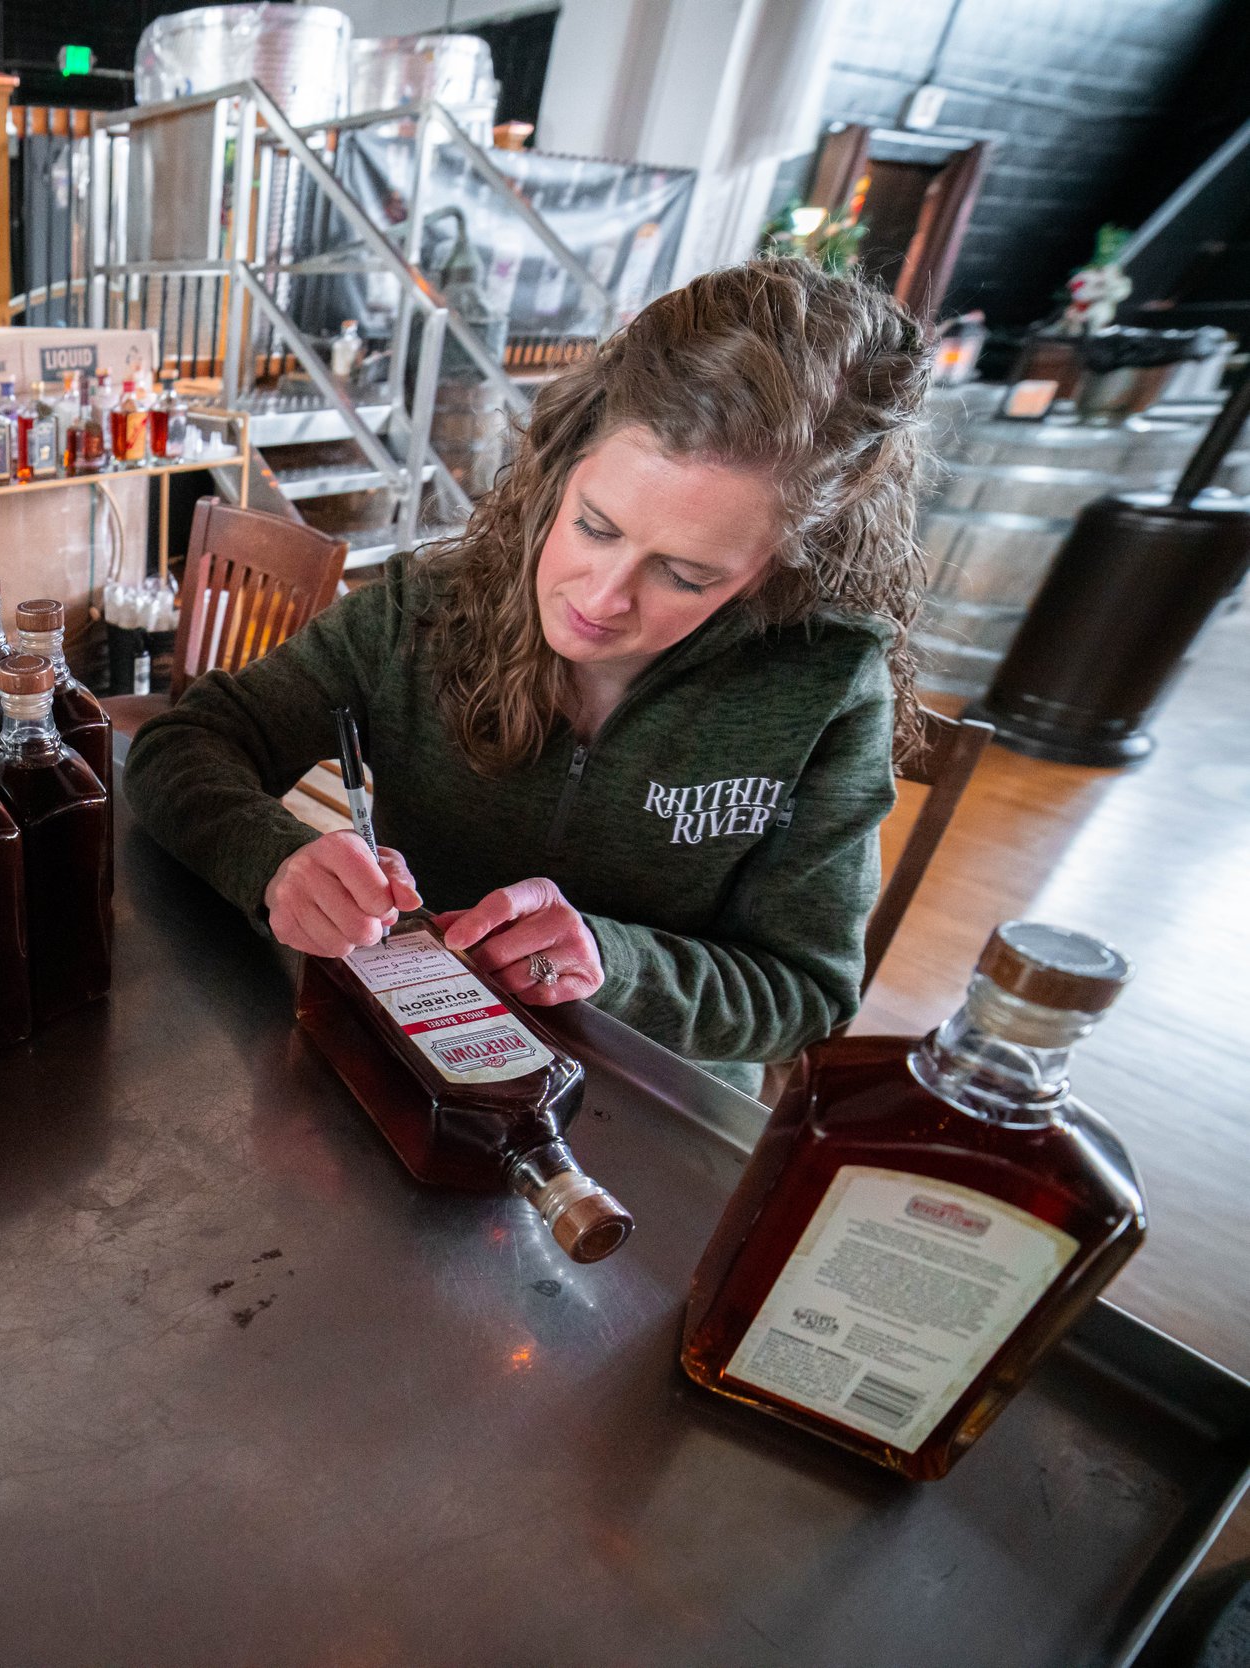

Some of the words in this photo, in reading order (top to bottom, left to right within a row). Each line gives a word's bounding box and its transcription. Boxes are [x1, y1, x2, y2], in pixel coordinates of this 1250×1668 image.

[46, 350, 93, 369] LIQUID
[643, 777, 785, 819] RHYTHM
[668, 805, 771, 845] RIVER
[397, 989, 480, 1013] BOURBON
[417, 989, 450, 999] WHISKEY
[443, 995, 483, 1009] KENTUCKY
[406, 1005, 444, 1018] STRAIGHT
[457, 1009, 490, 1022] SINGLE
[423, 1016, 459, 1030] BARREL
[438, 1033, 527, 1064] RIVERTOWN
